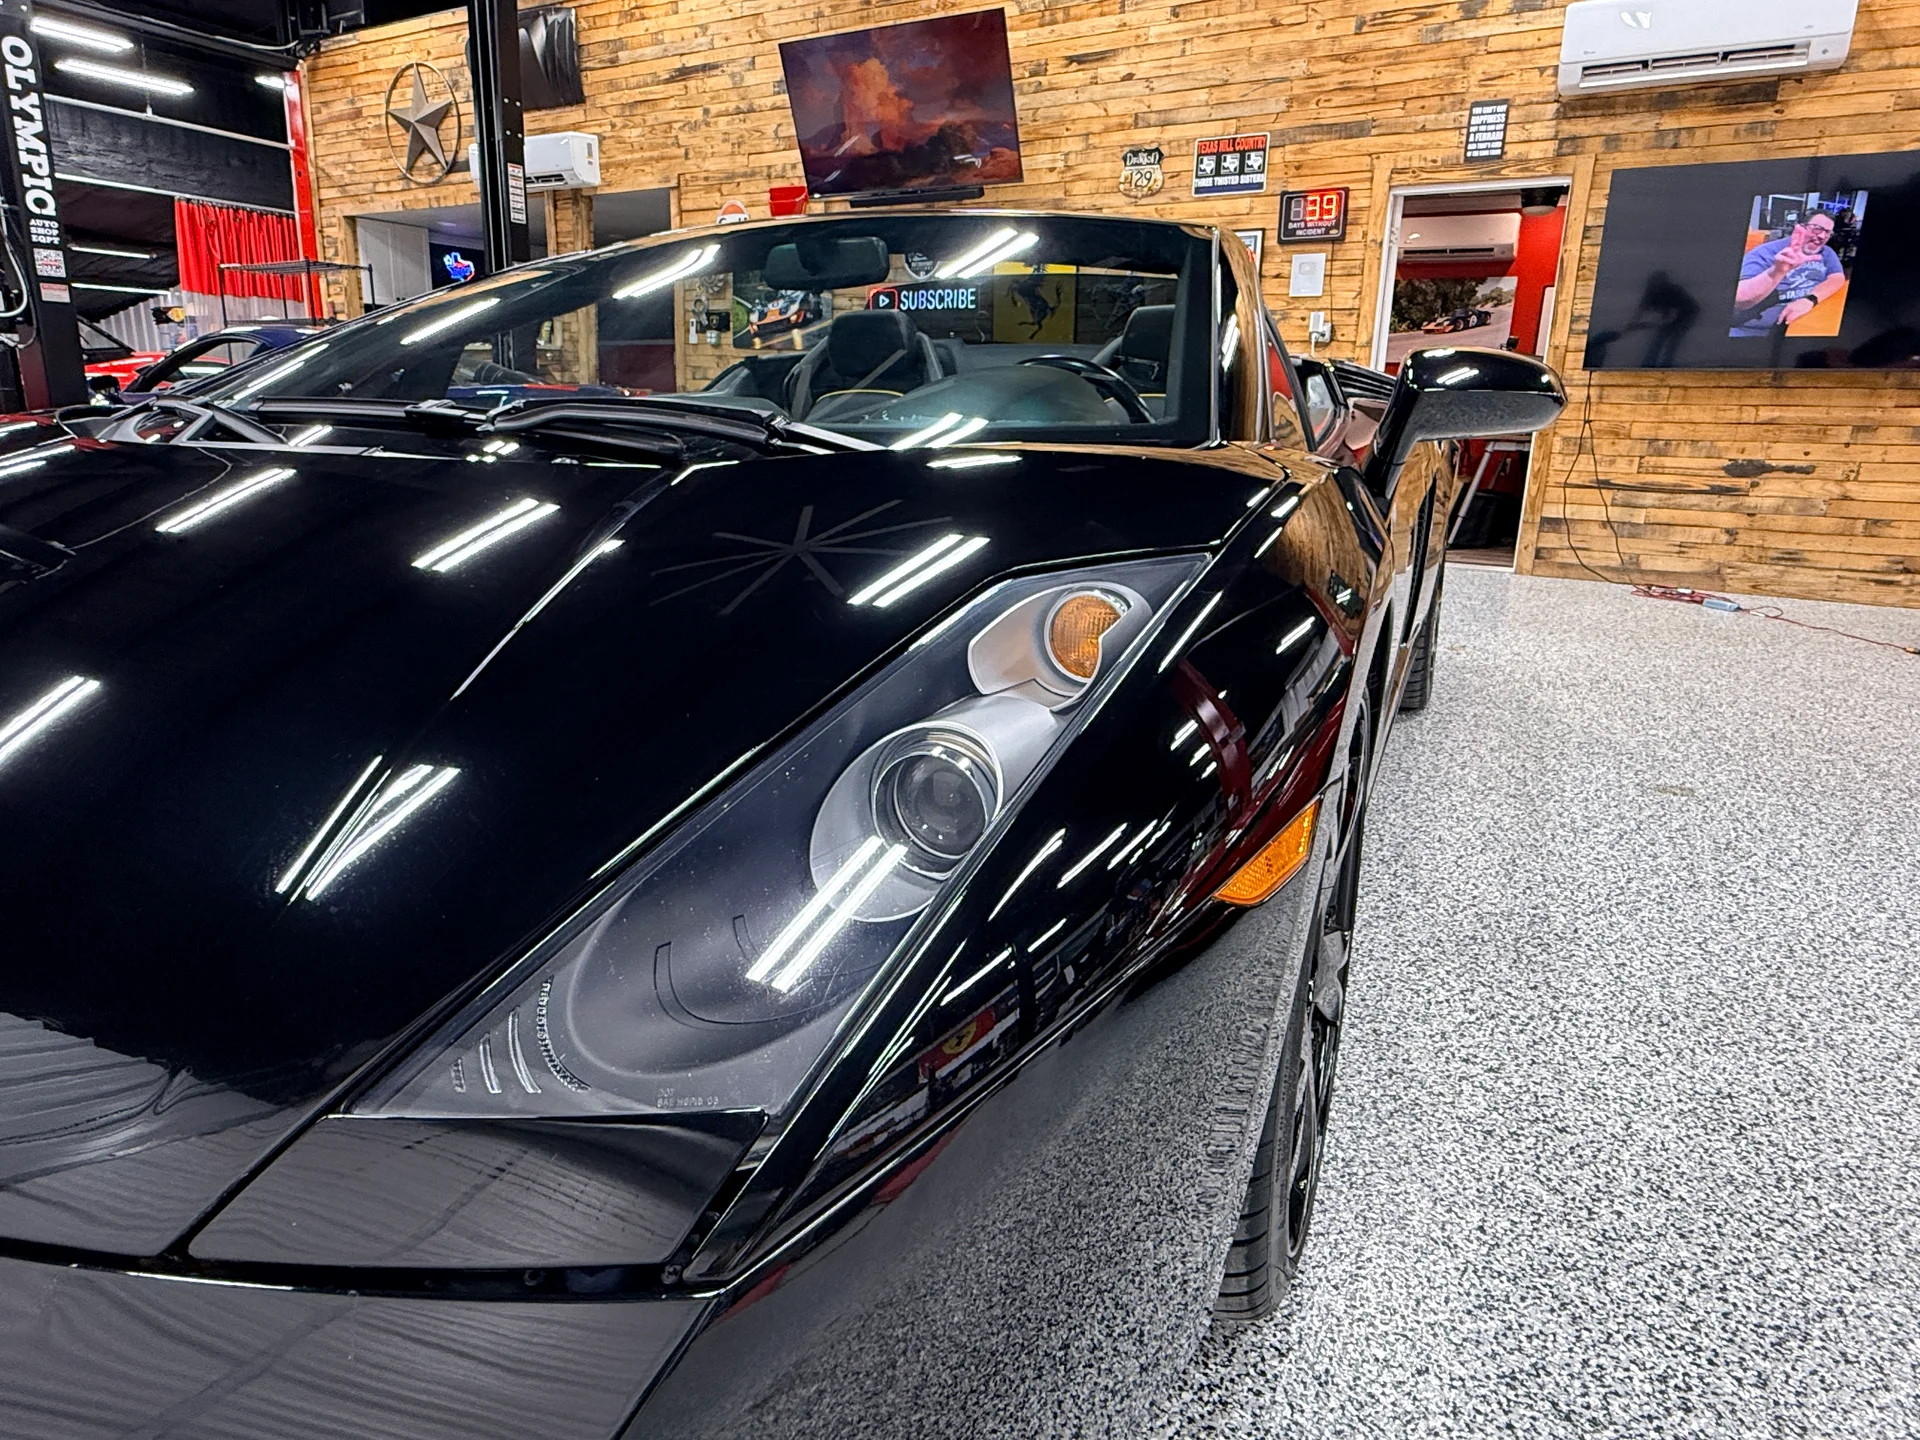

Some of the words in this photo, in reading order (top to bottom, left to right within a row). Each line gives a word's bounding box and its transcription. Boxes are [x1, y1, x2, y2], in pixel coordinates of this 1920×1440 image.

[1, 35, 57, 217] OLYMPIC
[1198, 140, 1218, 154] TEXAS
[1219, 138, 1234, 152] HILL
[1235, 136, 1266, 151] COUNTRY
[1129, 171, 1153, 188] 129
[29, 218, 59, 228] AUTO
[1288, 221, 1305, 229] DAYS
[1306, 220, 1337, 228] WITHOUT
[30, 226, 59, 236] SHOP
[1296, 228, 1326, 236] INCIDENT
[31, 234, 60, 245] EQPT
[900, 287, 976, 311] SUBSCRIBE
